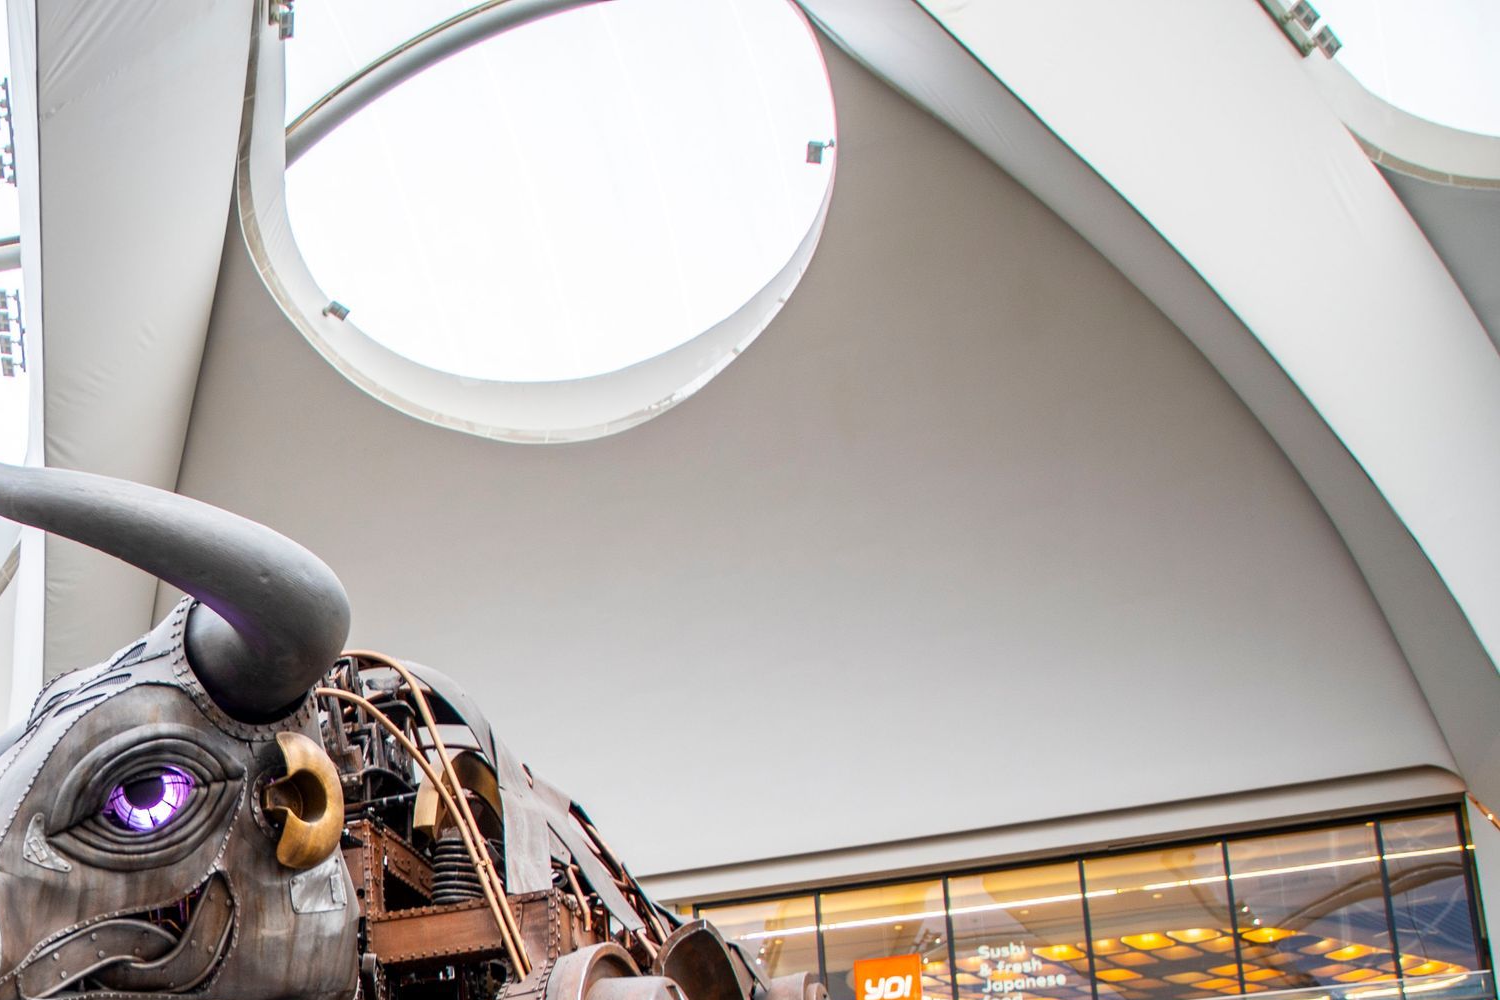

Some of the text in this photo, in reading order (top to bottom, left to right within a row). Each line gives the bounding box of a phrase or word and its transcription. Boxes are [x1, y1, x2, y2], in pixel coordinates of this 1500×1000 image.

[977, 941, 1026, 960] Sushi
[979, 957, 1043, 978] & fresh
[981, 973, 1067, 994] Japanese
